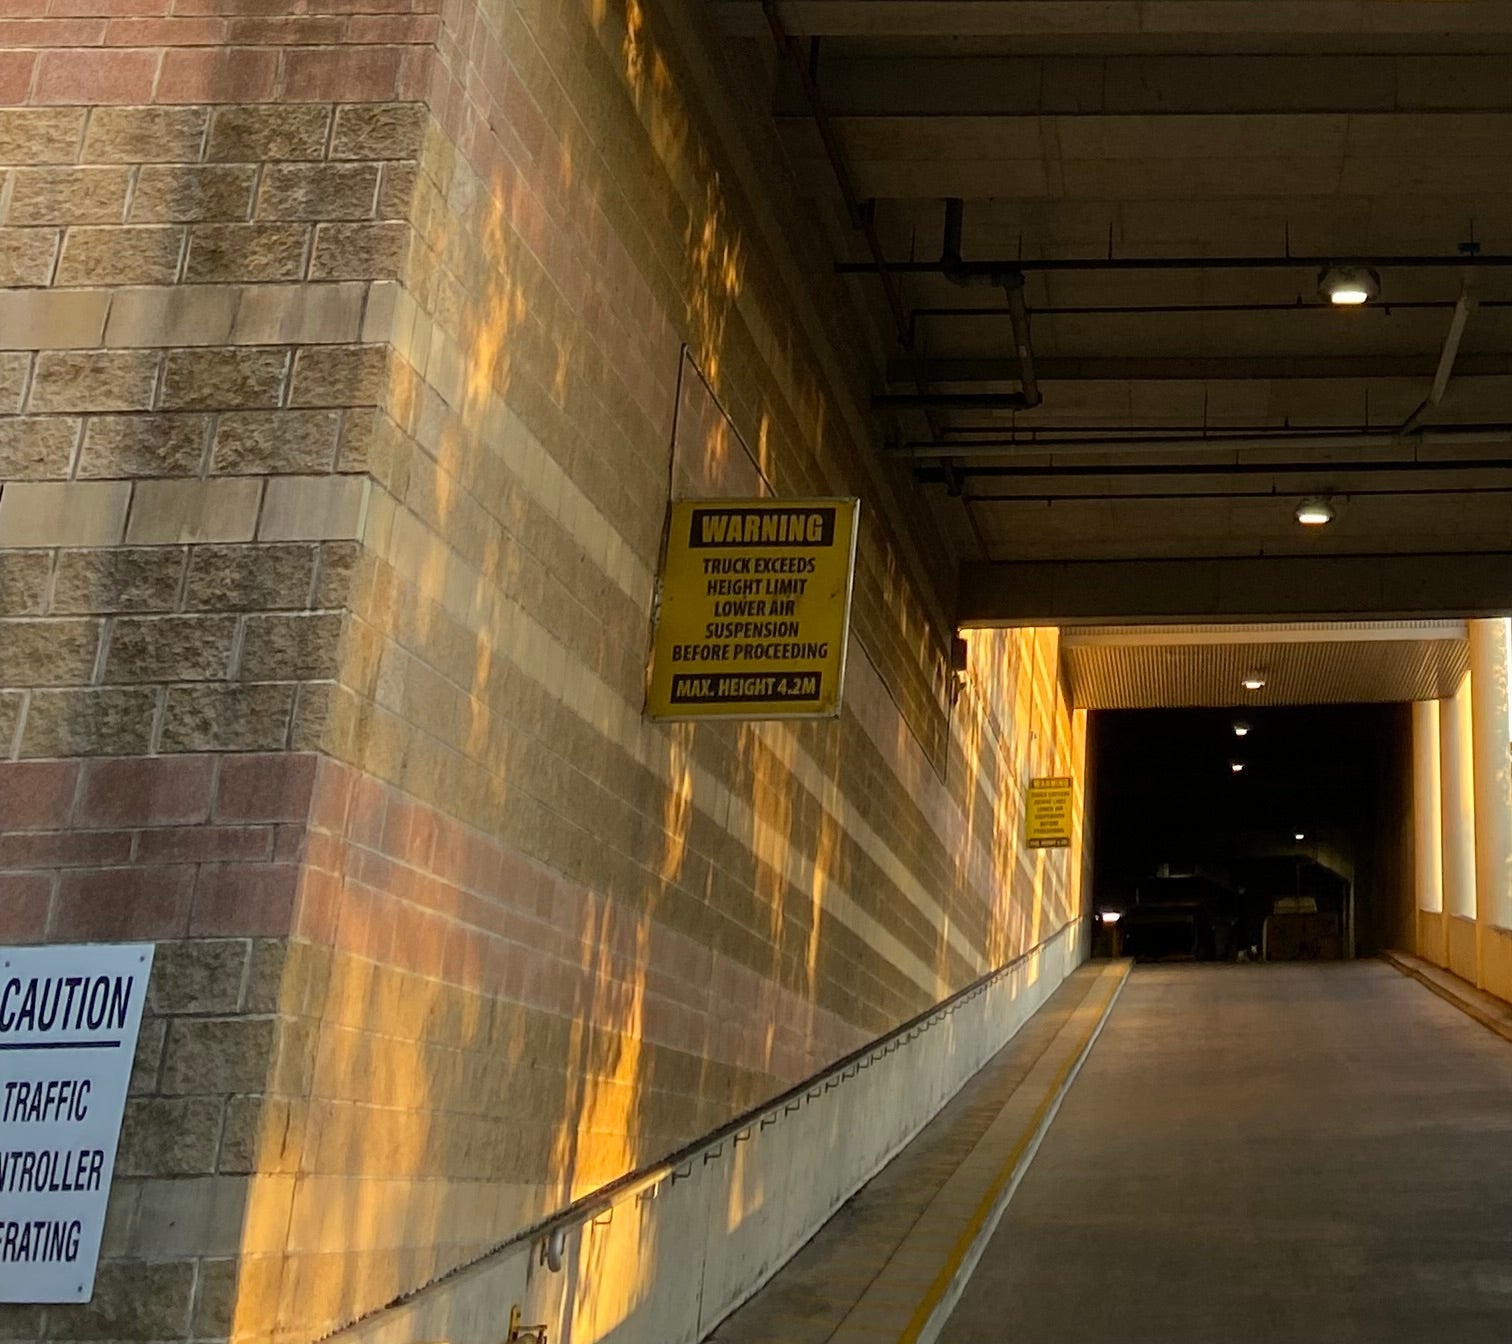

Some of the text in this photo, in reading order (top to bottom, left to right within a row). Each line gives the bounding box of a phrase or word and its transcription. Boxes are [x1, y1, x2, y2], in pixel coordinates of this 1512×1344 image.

[702, 514, 823, 543] WARNING
[703, 557, 815, 574] TRUCK EXCEEDS
[707, 578, 807, 596] HEIGHT LIMIT
[714, 600, 795, 617] LOWER AIR
[705, 621, 799, 639] SUSPENSION
[672, 642, 828, 662] BEFORE PROCEEDING
[677, 677, 816, 697] MAX. HEIGHT 4.2M
[0, 976, 134, 1032] CAUTION
[3, 1079, 92, 1123] TRAFFIC
